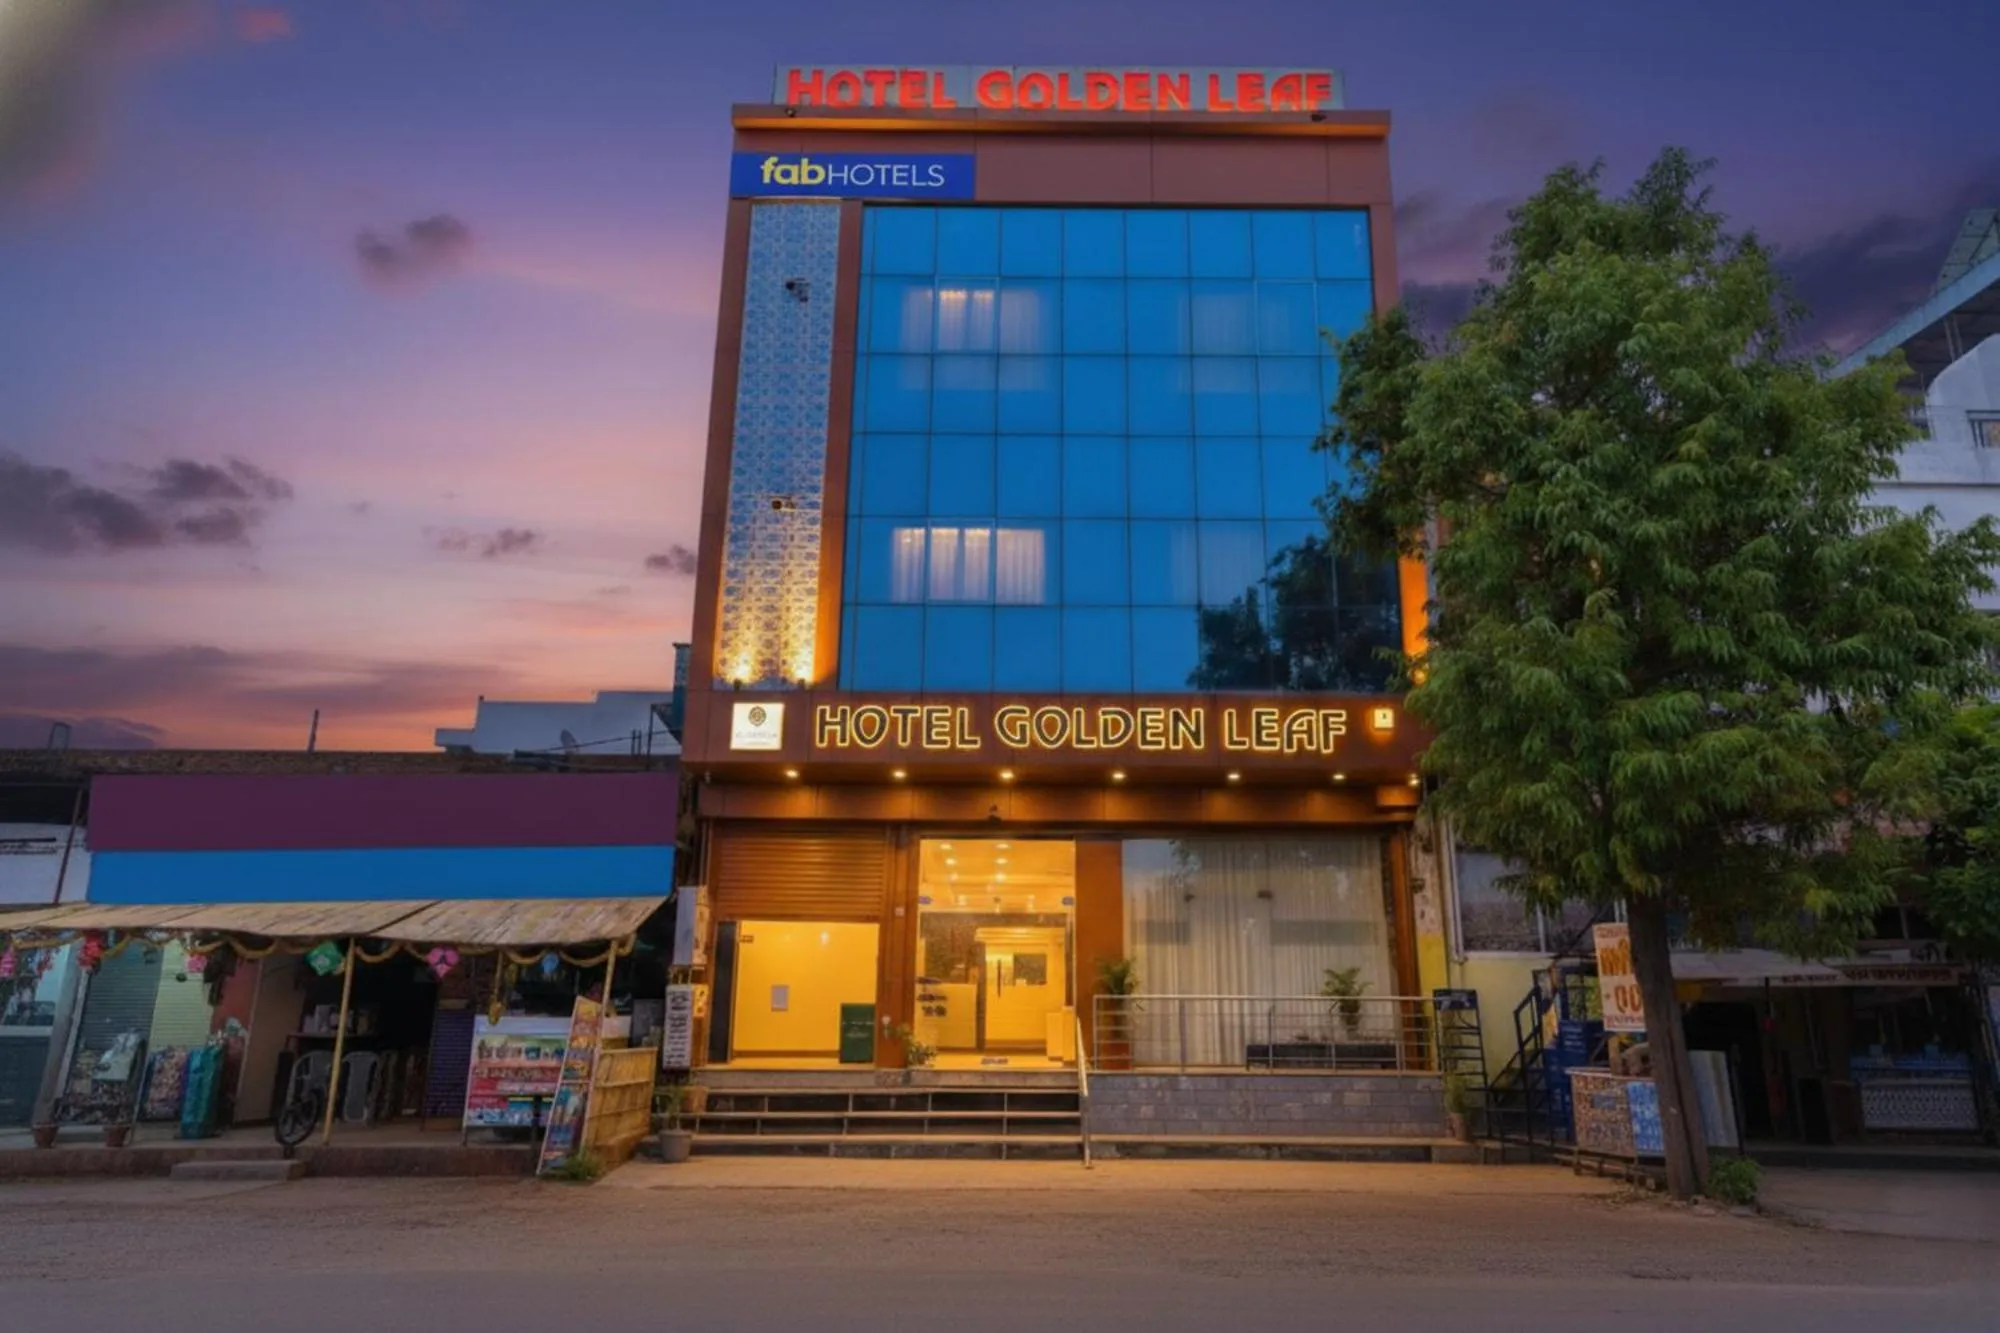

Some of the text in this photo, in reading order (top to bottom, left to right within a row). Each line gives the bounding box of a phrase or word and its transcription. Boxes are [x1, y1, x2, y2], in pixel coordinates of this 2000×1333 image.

[787, 69, 1332, 112] HOTEL GOLDEN LEAF
[816, 705, 1347, 754] HOTEL GOLDEN LEAF
